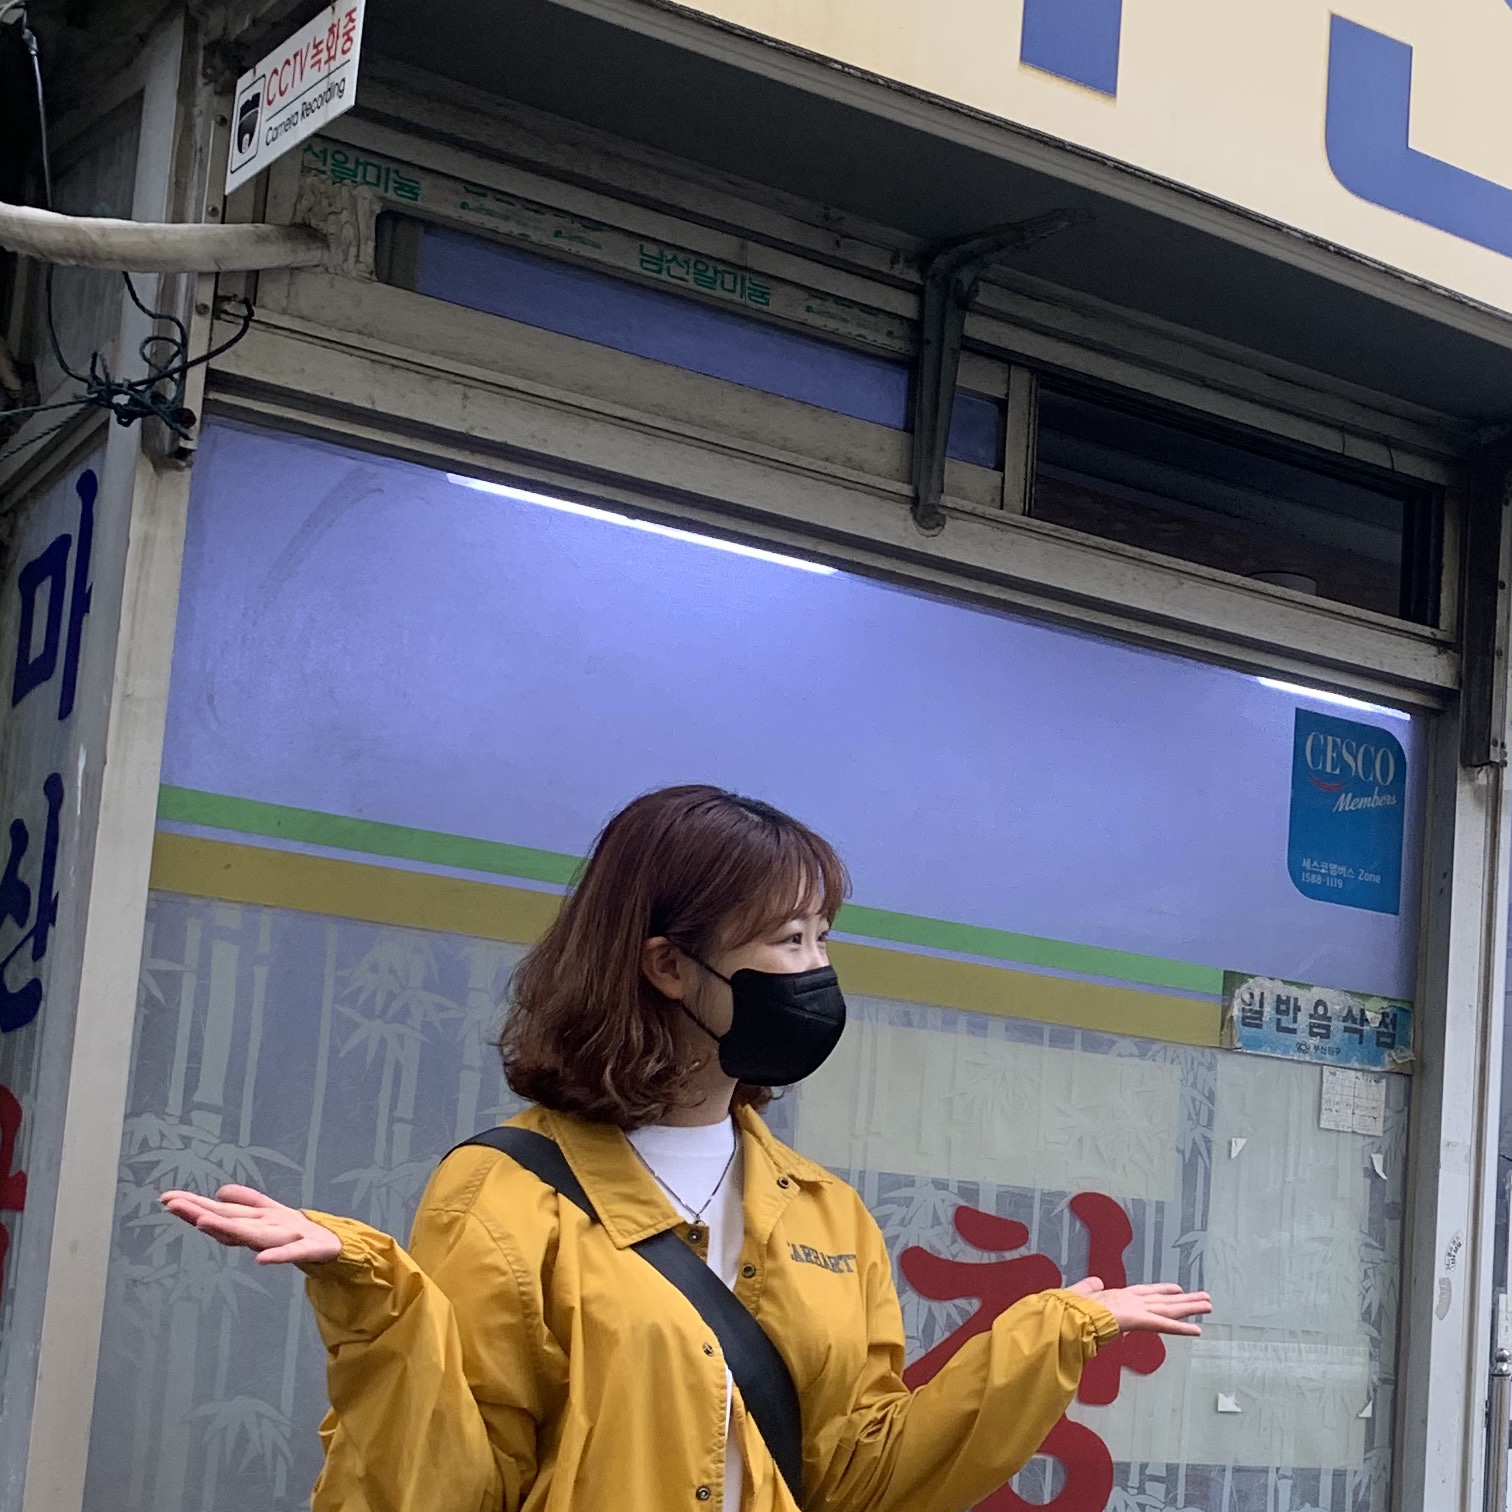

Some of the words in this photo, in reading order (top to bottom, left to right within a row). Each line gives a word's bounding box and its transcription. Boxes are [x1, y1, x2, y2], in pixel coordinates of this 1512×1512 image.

[266, 7, 357, 106] CCTV녹화중
[265, 108, 299, 147] Camera
[300, 76, 346, 123] Recording
[638, 242, 770, 307] 남선알미늄
[1305, 731, 1395, 786] CESCO
[1332, 787, 1397, 813] Members
[1357, 868, 1381, 884] Zone
